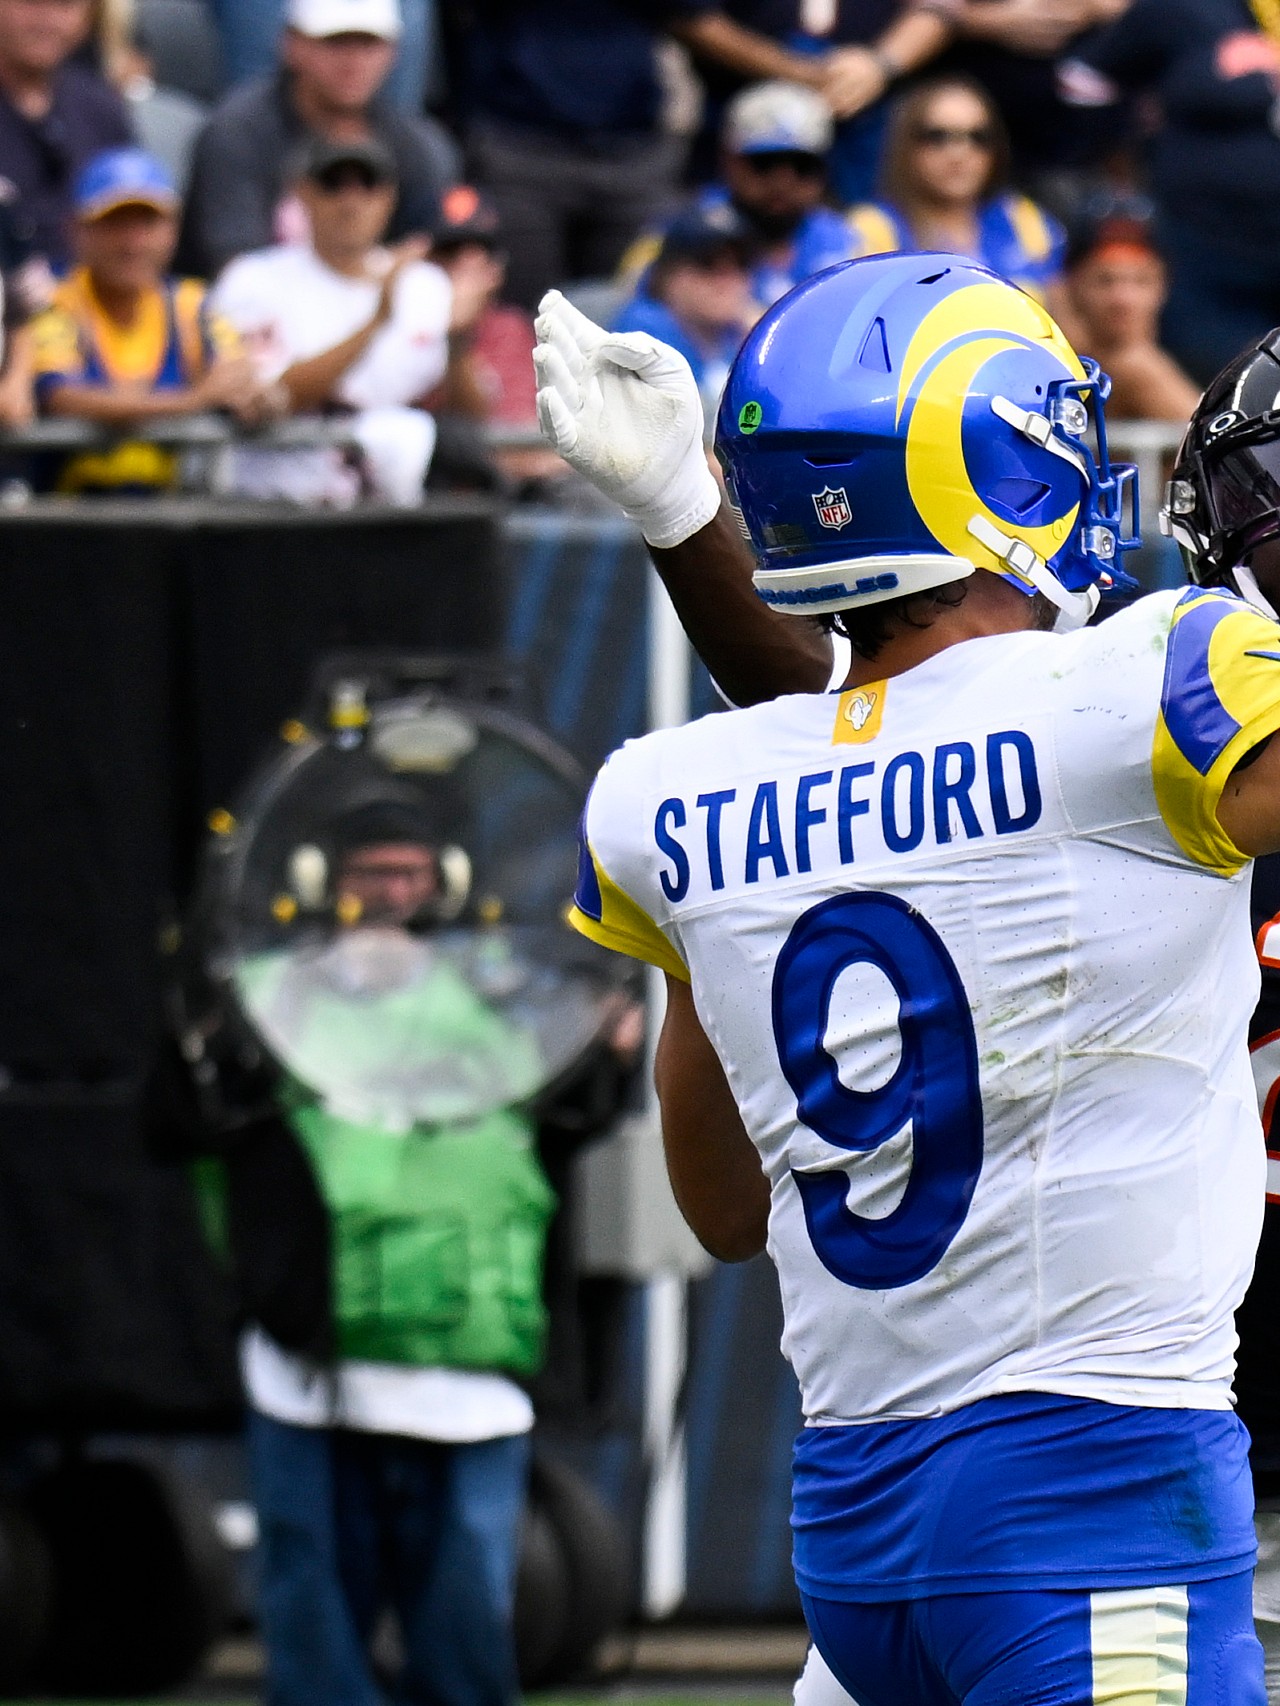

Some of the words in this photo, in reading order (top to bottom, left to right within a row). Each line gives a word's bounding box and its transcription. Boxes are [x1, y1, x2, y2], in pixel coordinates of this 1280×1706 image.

[820, 504, 848, 524] NFL
[654, 730, 1043, 903] STAFFORD
[771, 890, 984, 1290] 9
